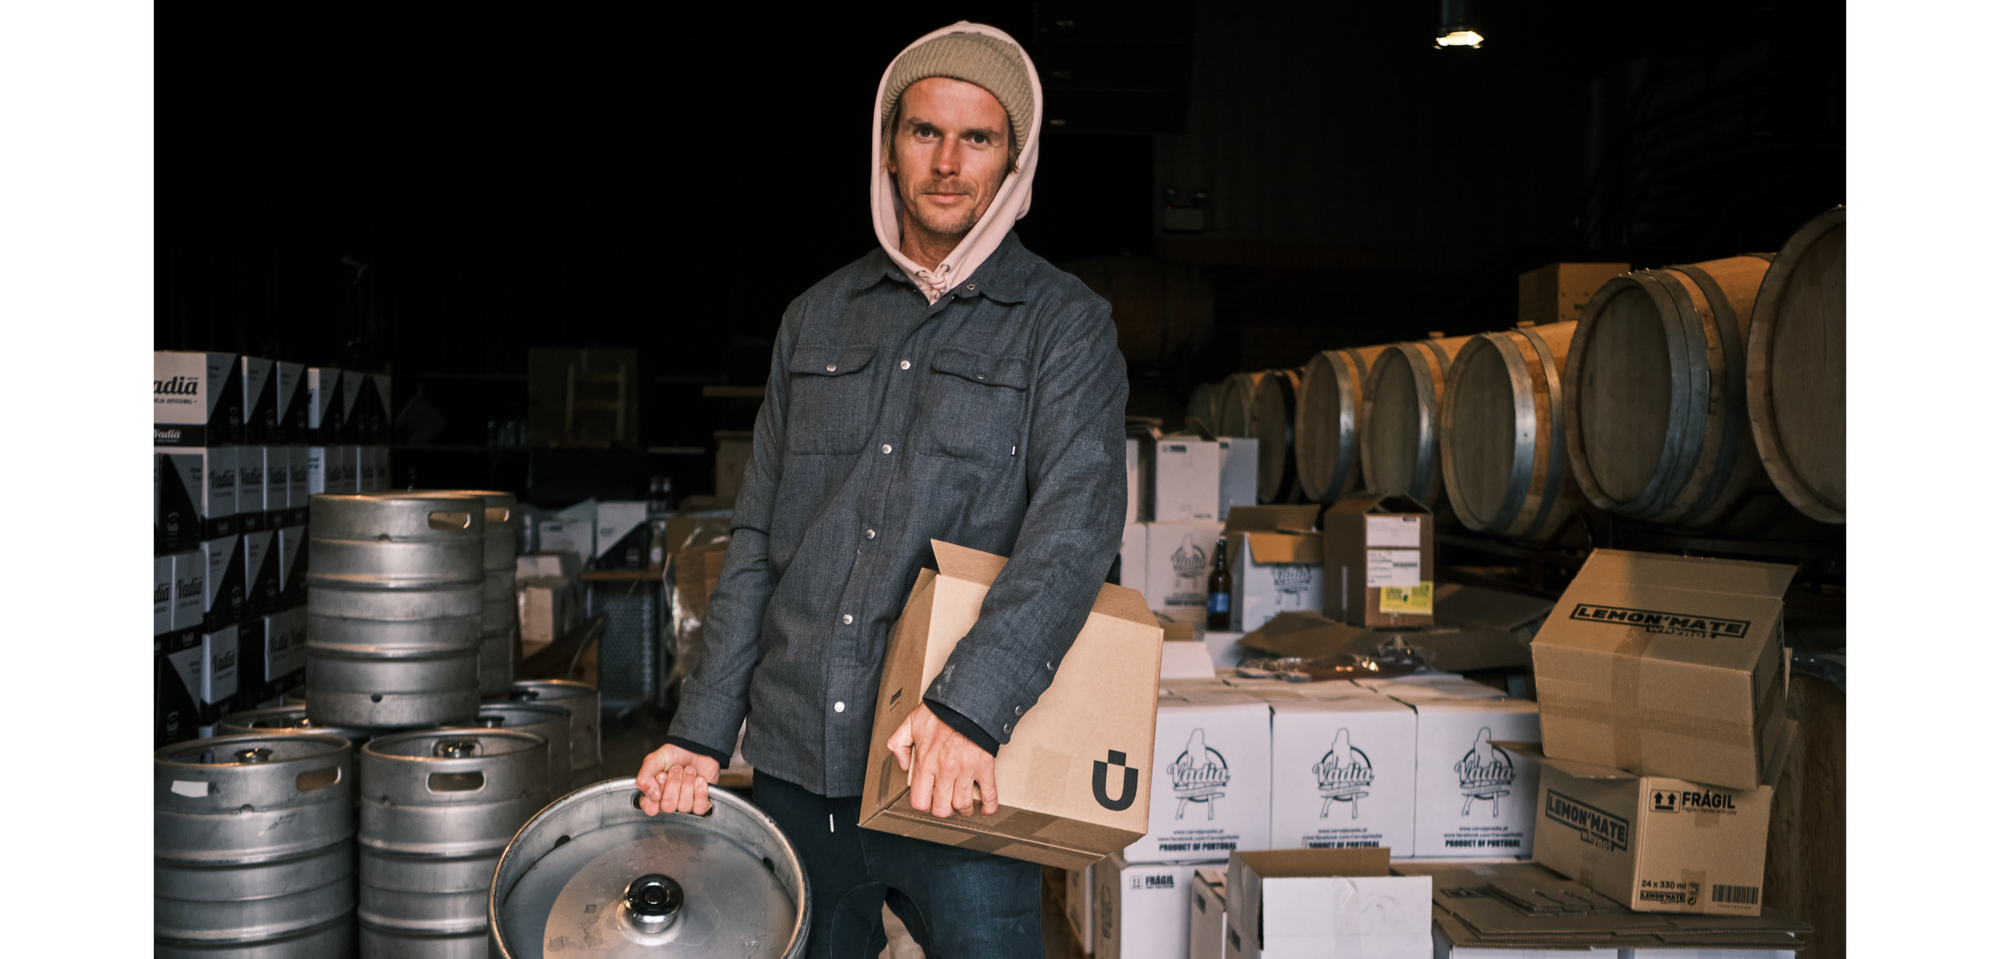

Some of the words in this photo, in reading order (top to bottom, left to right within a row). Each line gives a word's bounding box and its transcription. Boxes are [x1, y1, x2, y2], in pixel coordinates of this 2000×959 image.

[210, 469, 234, 489] Vadia
[176, 577, 202, 599] Vadia
[1577, 607, 1743, 634] LEMON'MATE
[1166, 762, 1230, 786] Vadia
[1312, 761, 1374, 785] Vadia
[1453, 760, 1515, 785] Vadia
[1682, 789, 1736, 810] FRÁGIL
[1548, 795, 1626, 843] LEMON'MATE
[1159, 843, 1191, 851] PRODUCT
[1193, 843, 1202, 851] OF
[1202, 842, 1237, 851] PORTUGAL
[1445, 840, 1476, 848] PRODUCT
[1478, 840, 1486, 848] OF
[1487, 840, 1521, 848] PORTUGAL
[1145, 874, 1174, 886] FRÁGIL
[1641, 880, 1652, 888] 24
[1660, 881, 1675, 889] 330
[1676, 882, 1687, 890] ml
